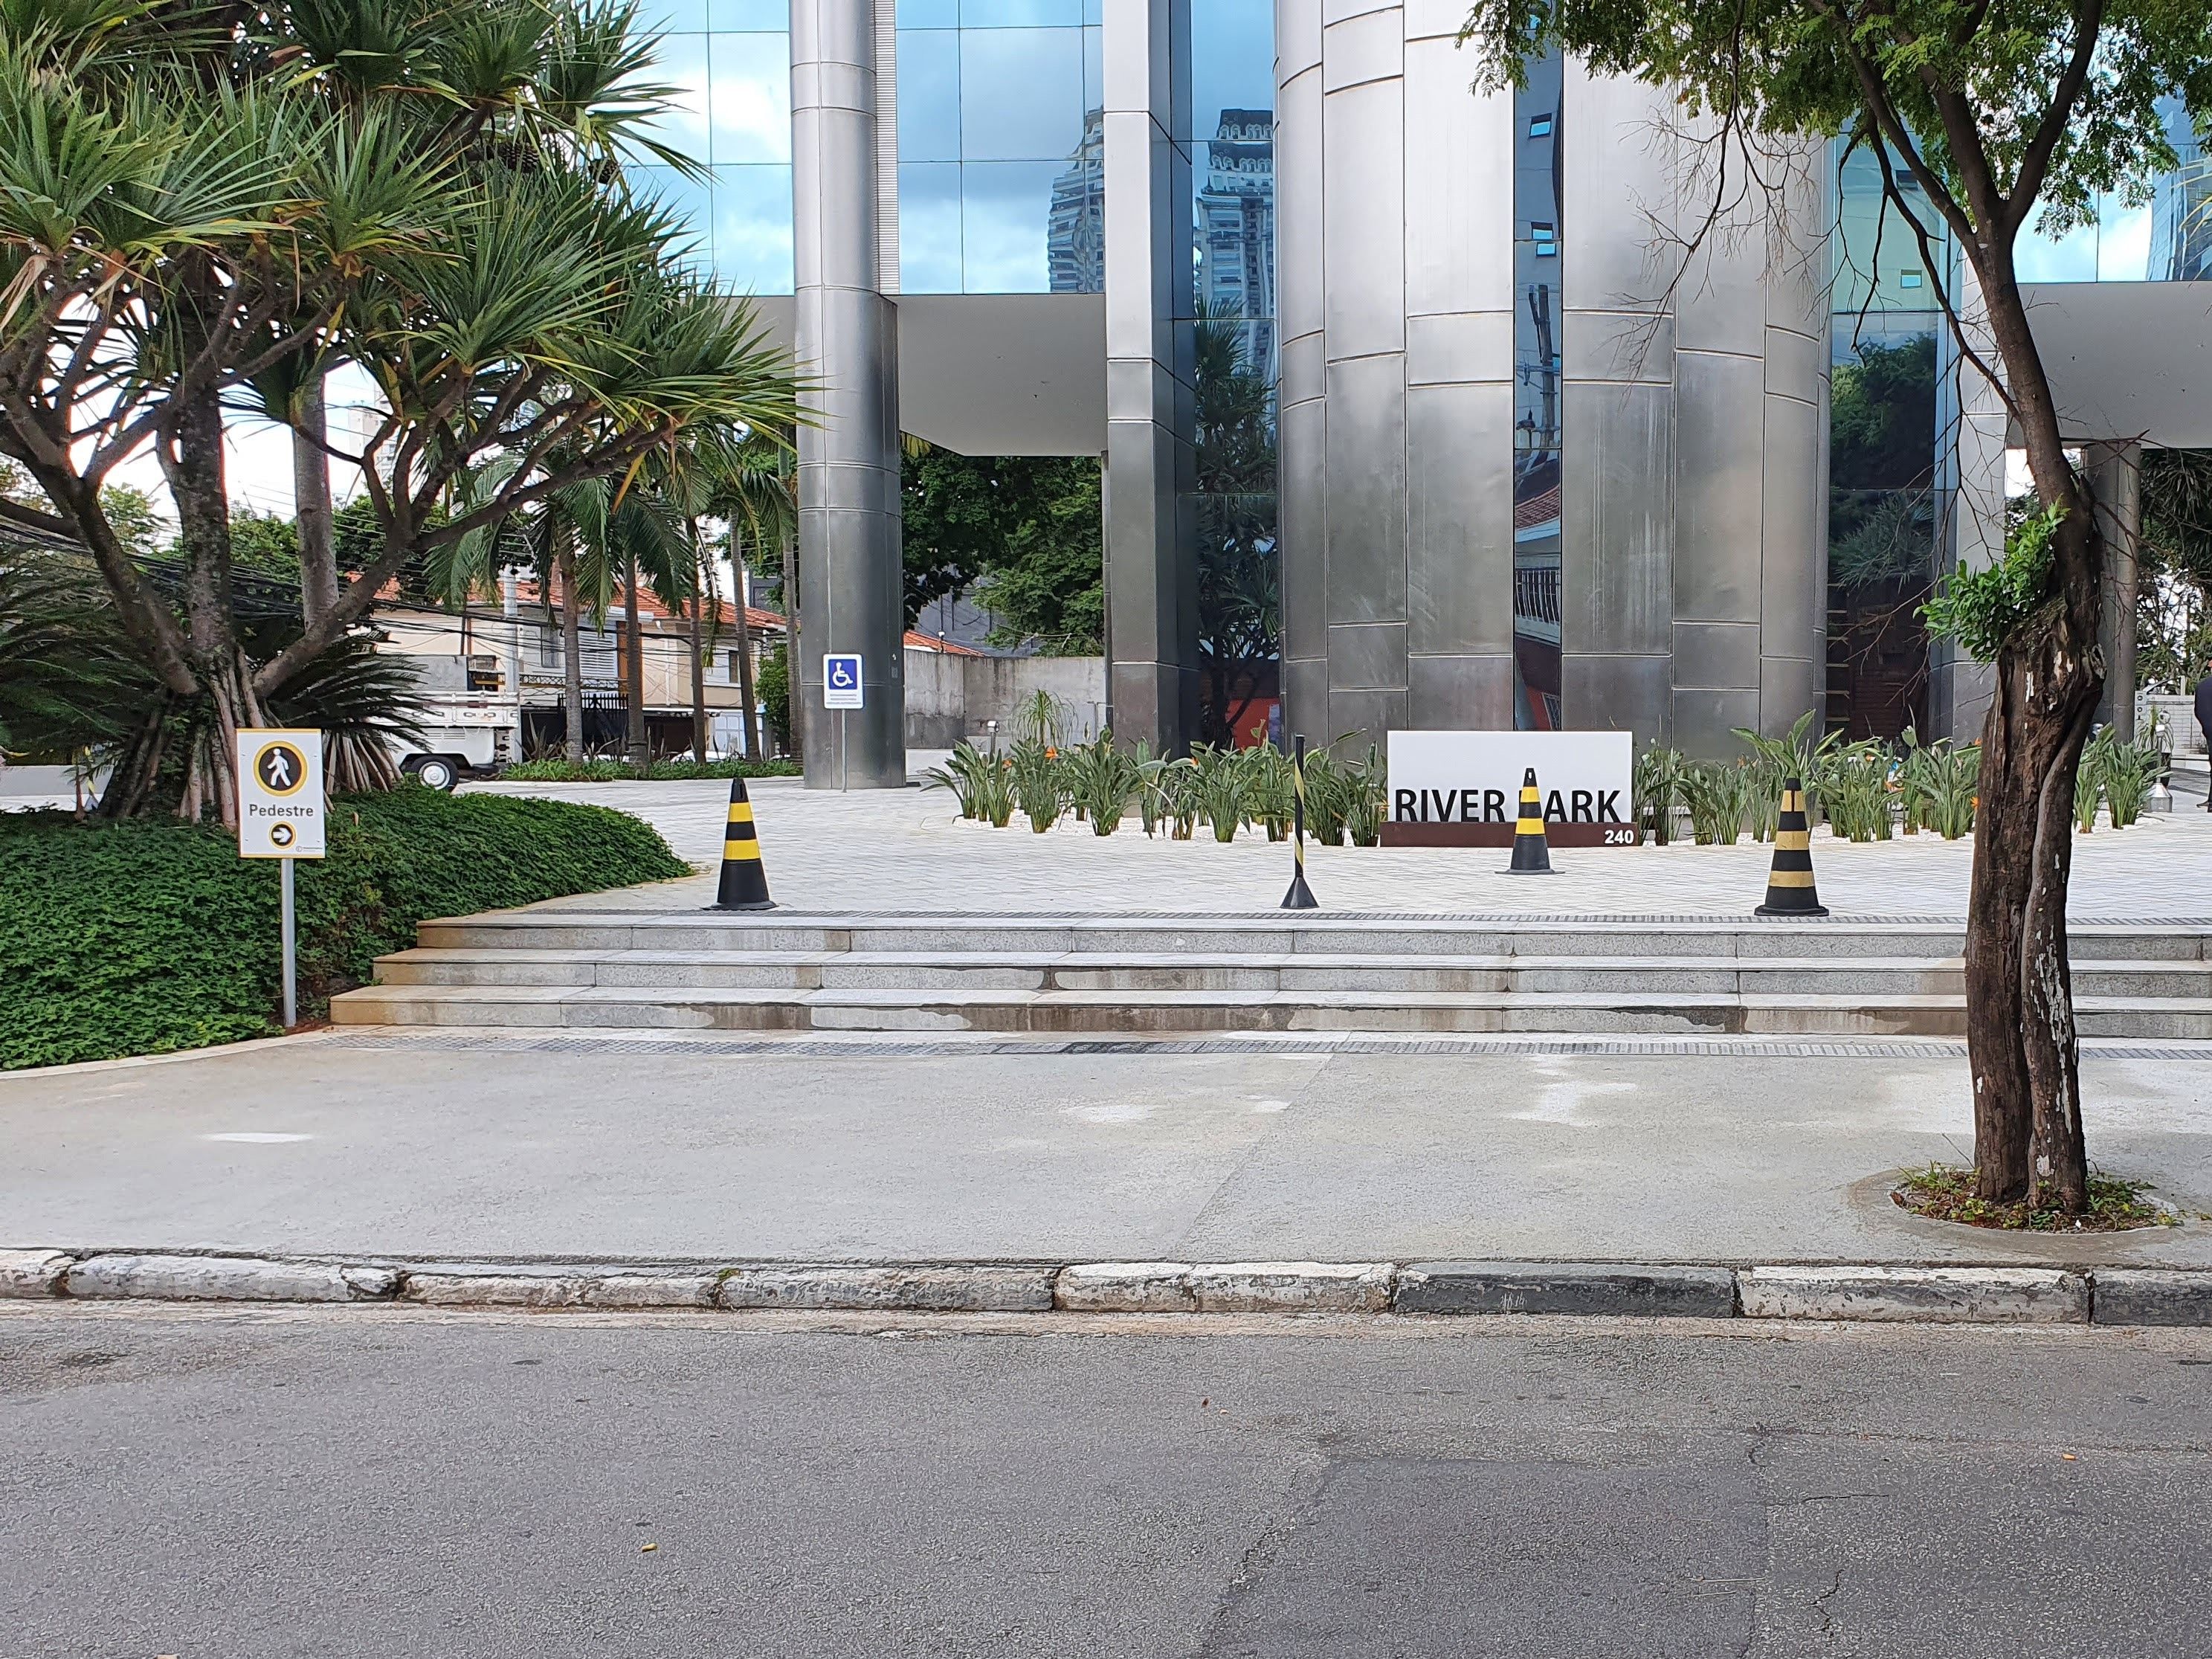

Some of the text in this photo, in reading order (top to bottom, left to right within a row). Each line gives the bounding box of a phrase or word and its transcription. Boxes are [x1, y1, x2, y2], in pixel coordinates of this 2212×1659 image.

[249, 804, 314, 816] Pedestre
[1395, 789, 1621, 823] RIVER ARK
[1605, 830, 1634, 844] 240
